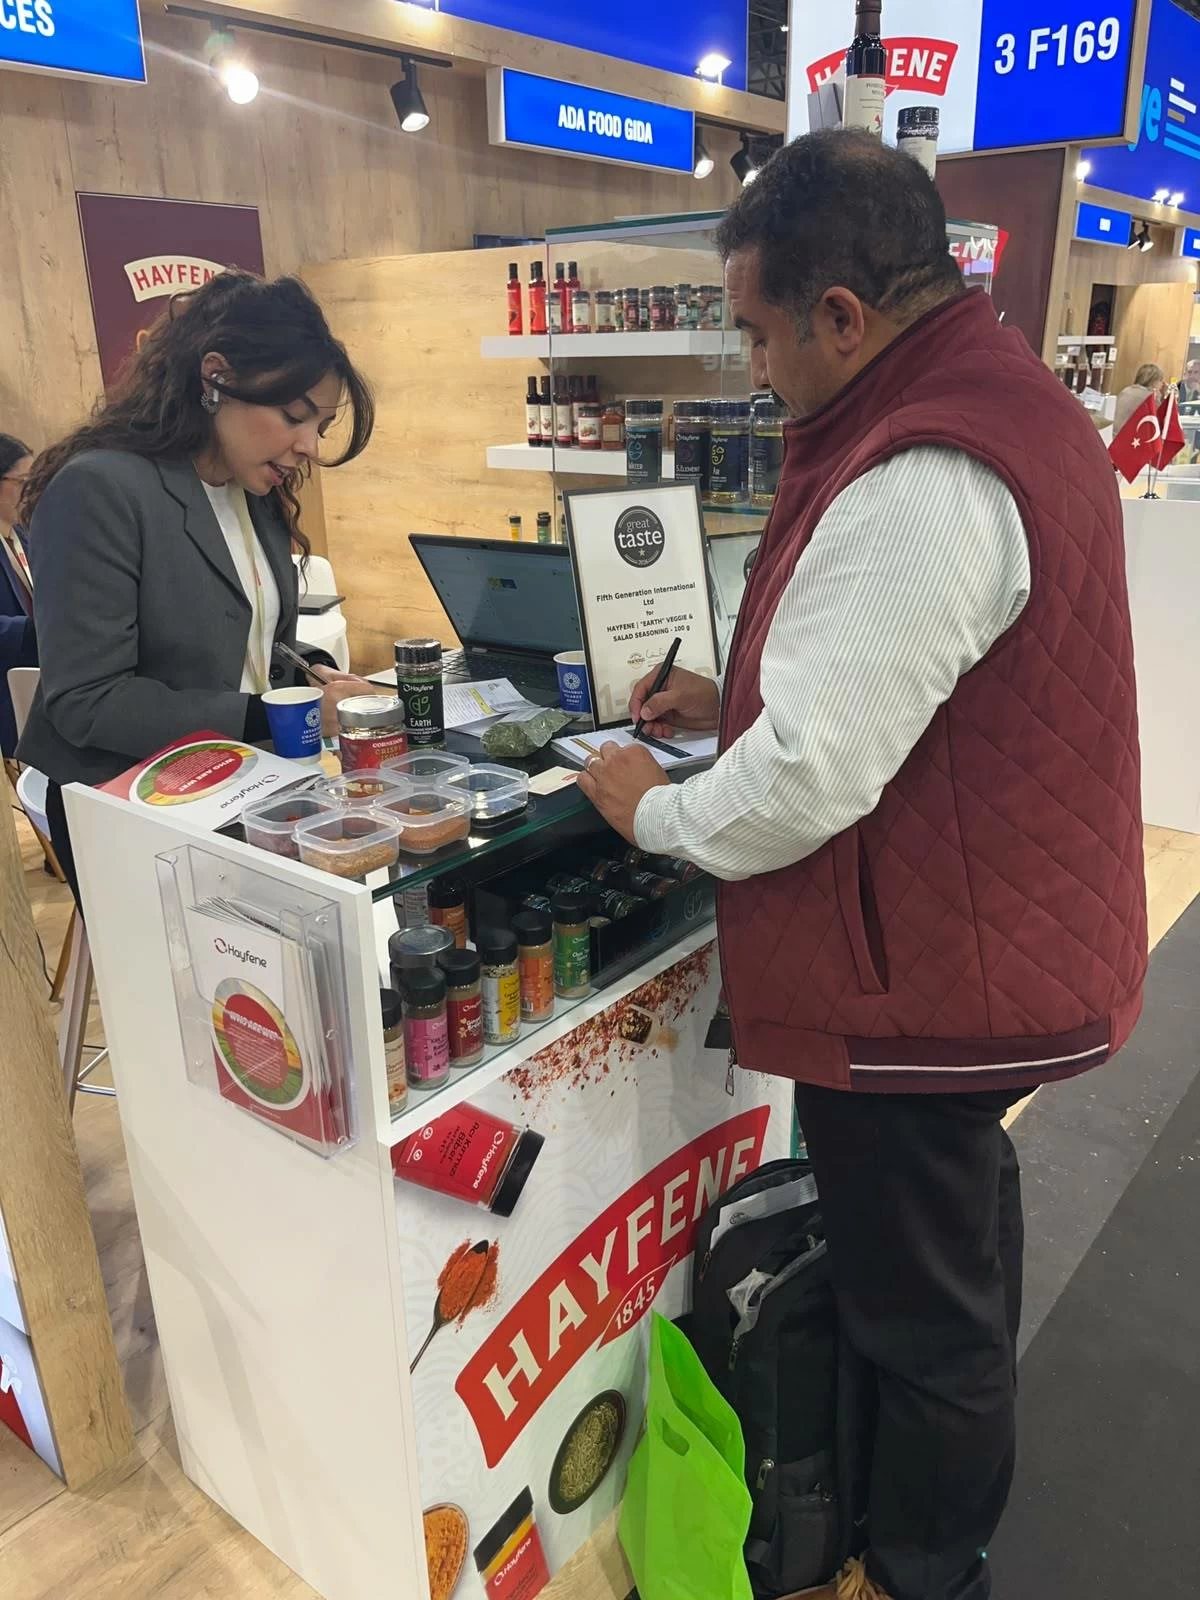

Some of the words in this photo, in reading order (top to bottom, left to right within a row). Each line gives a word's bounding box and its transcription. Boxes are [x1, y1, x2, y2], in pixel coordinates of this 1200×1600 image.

[994, 33, 1016, 75] 3
[1028, 17, 1120, 70] F169
[814, 48, 948, 86] HENE
[558, 104, 586, 132] ADA
[588, 110, 622, 139] FOOD
[624, 118, 653, 144] GIDA
[133, 264, 215, 291] HAYFEN
[618, 530, 662, 548] taste
[626, 519, 650, 533] great
[596, 593, 613, 602] Fifth
[615, 589, 652, 600] Generation
[654, 582, 696, 594] International
[643, 598, 654, 606] Ltd
[606, 623, 635, 632] HAYFENE
[666, 615, 688, 623] VEGGIE
[613, 633, 634, 642] SALAD
[635, 628, 669, 638] SEASONING
[220, 781, 263, 809] Hayfene
[227, 944, 267, 968] Hayfene
[472, 1144, 498, 1189] Hayfene
[482, 1136, 755, 1421] HAYFENE
[615, 1276, 657, 1330] 1845
